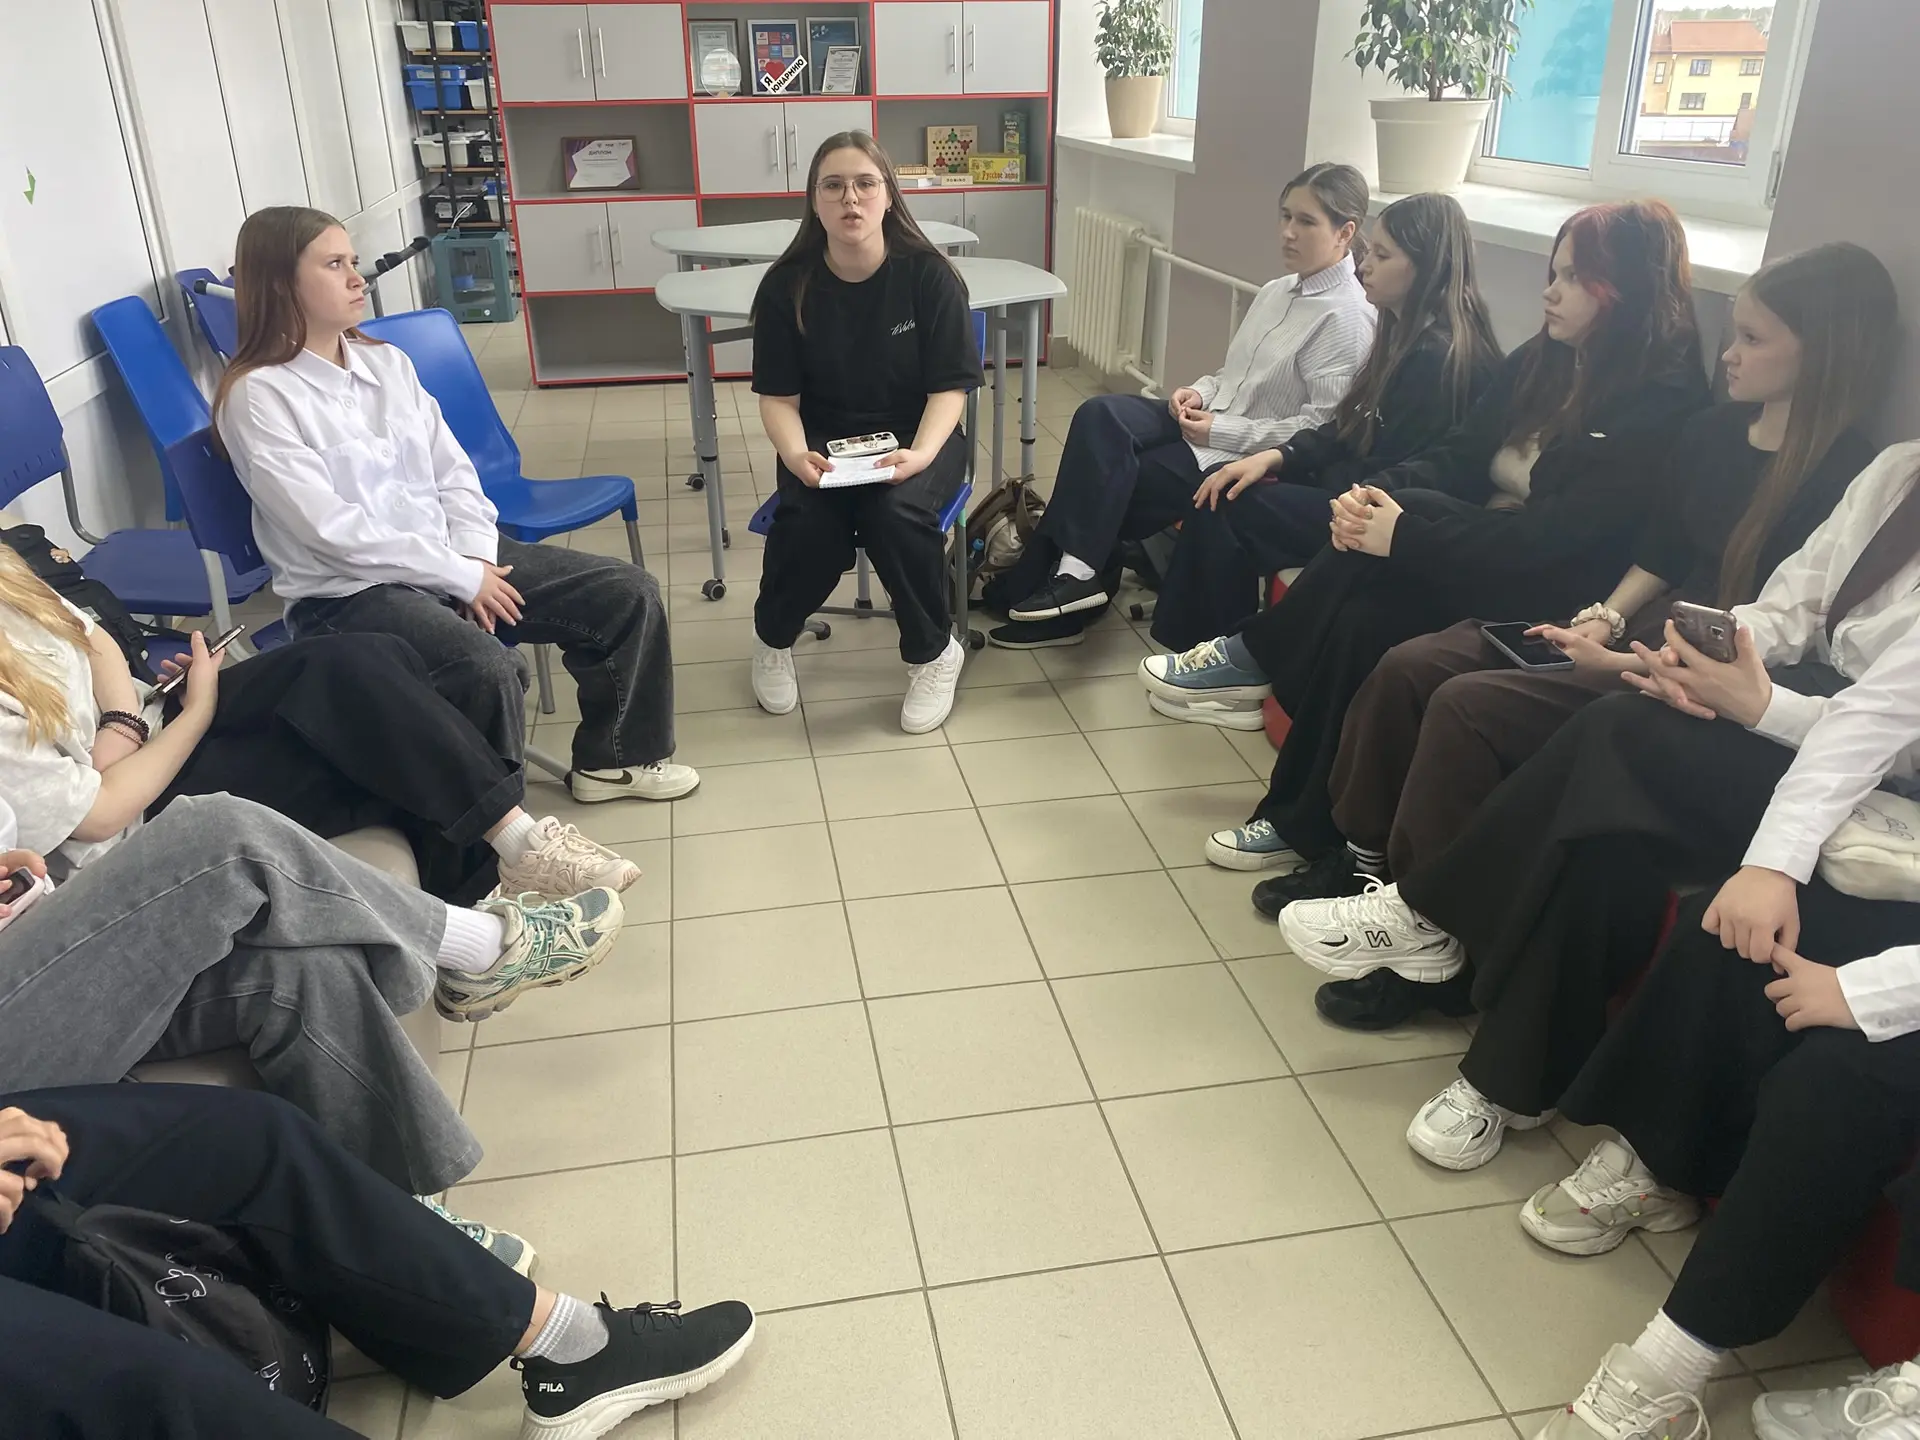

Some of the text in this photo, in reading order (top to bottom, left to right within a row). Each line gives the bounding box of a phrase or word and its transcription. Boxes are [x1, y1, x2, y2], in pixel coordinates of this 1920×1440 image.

[771, 58, 804, 93] ЮНАРМИЮ
[764, 76, 773, 86] Я
[538, 1383, 565, 1392] FILA
